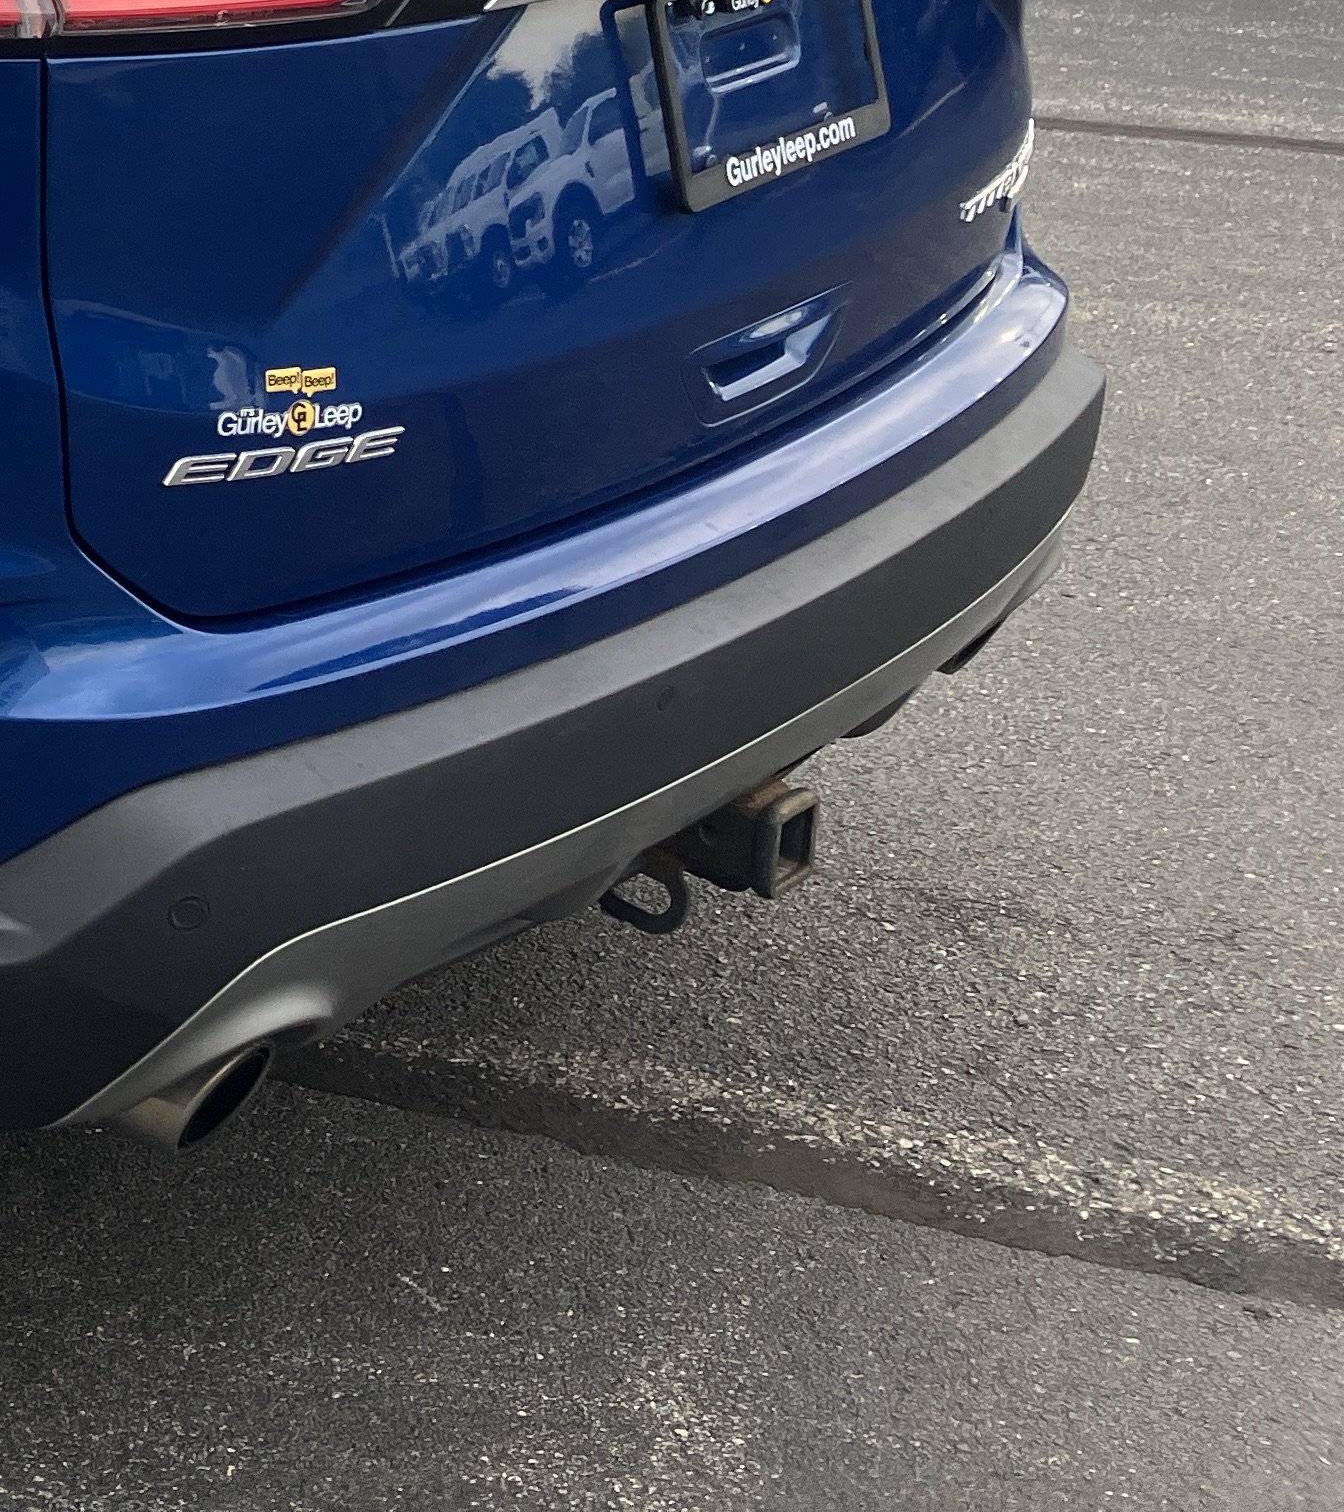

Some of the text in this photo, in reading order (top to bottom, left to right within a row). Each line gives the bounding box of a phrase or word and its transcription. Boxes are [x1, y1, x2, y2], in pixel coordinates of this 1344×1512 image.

[725, 116, 857, 187] Gurleyleep.com
[268, 372, 335, 388] Beep! Beep!
[217, 410, 288, 439] Gurley
[313, 402, 363, 431] Leep
[162, 425, 406, 487] EDGE
